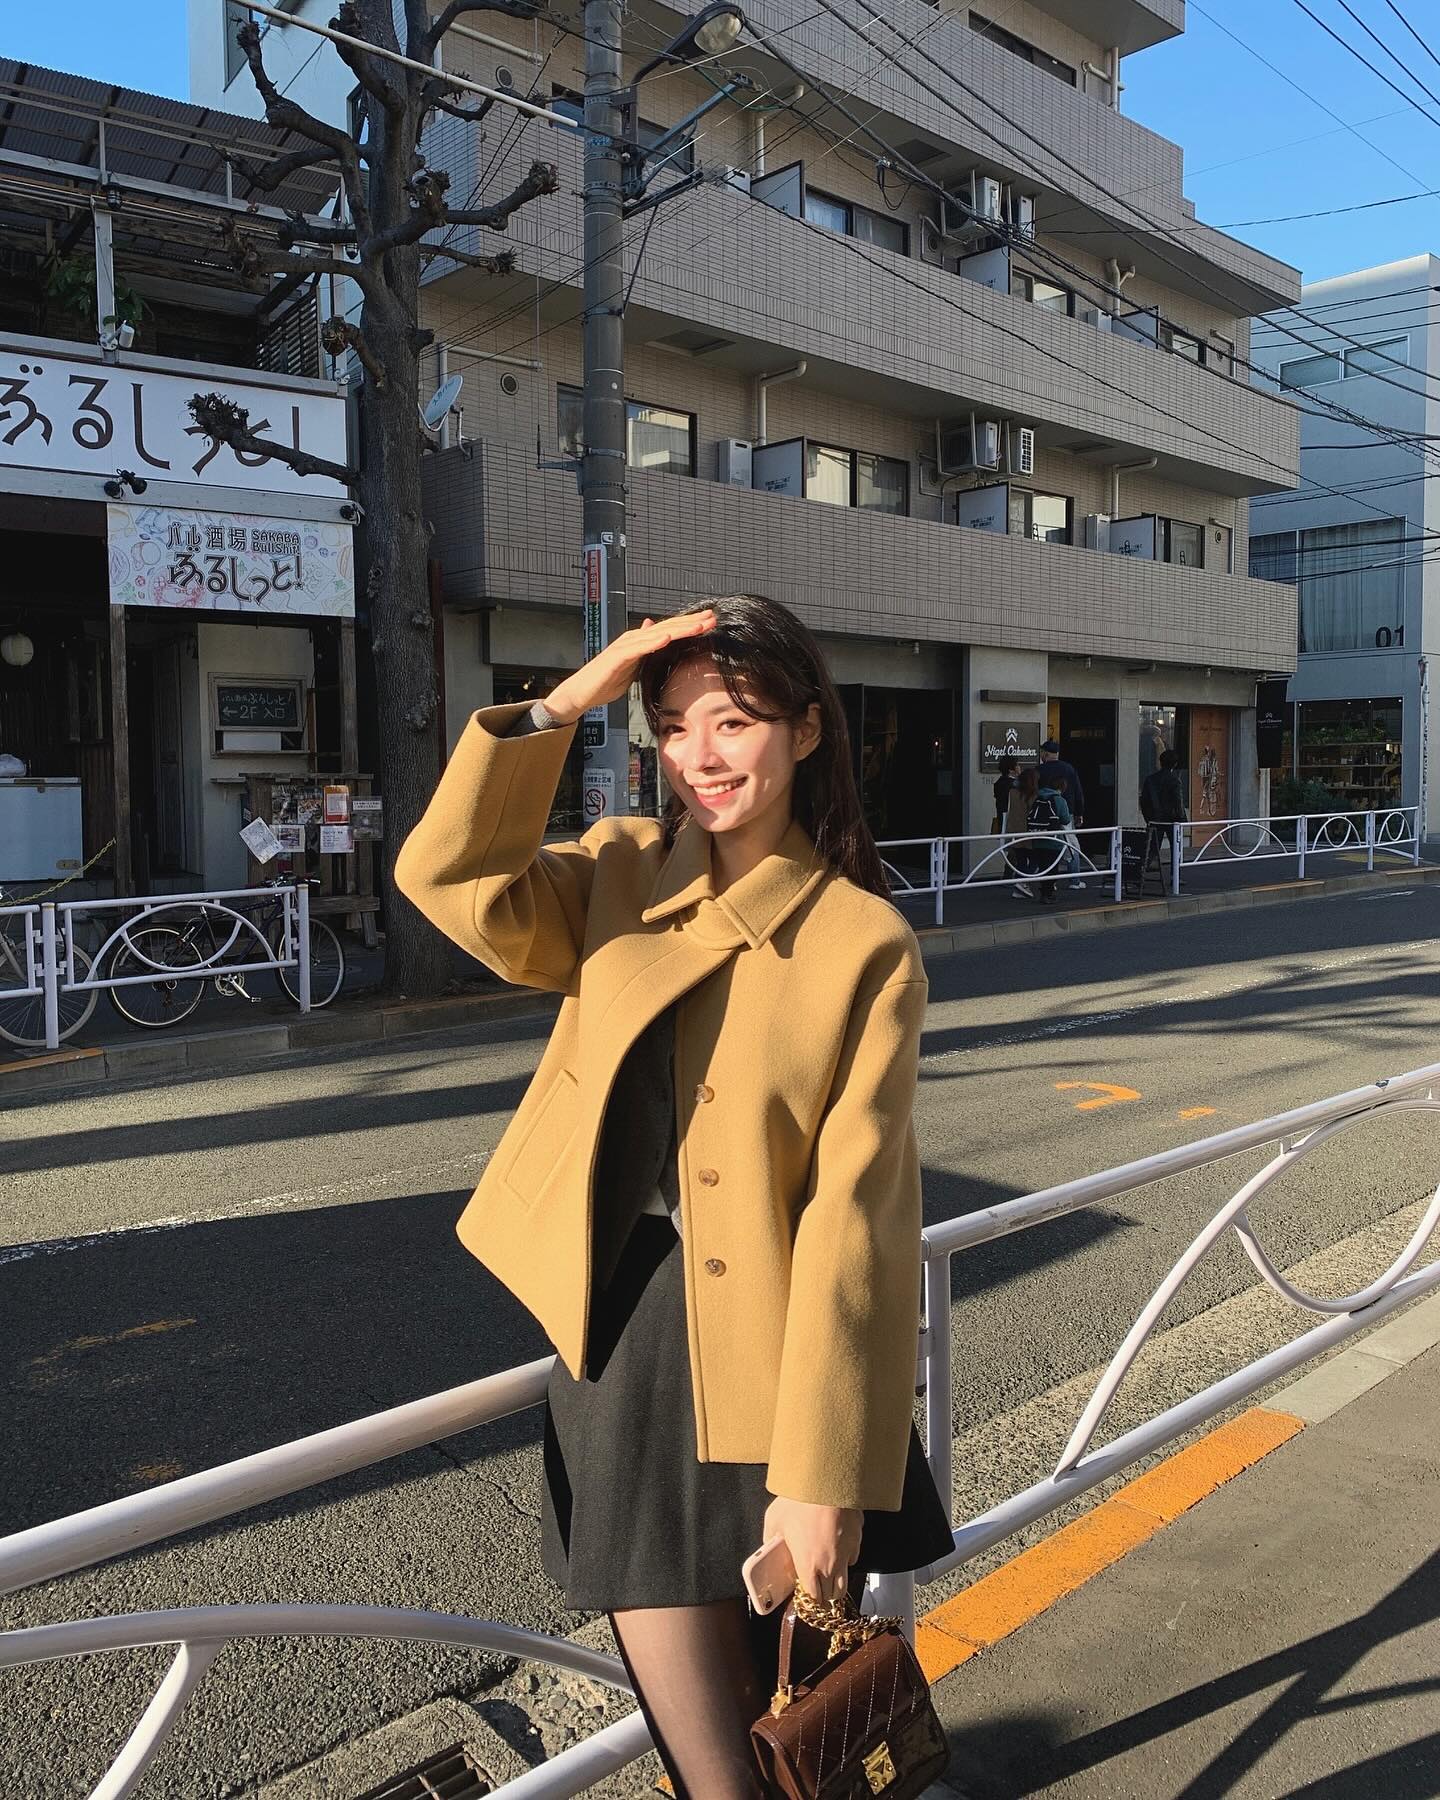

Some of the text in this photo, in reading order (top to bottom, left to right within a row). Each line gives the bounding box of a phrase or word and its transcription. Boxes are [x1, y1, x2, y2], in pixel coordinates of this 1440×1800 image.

[166, 522, 247, 551] バル酒場
[251, 529, 300, 543] SAKABA
[167, 545, 303, 605] ぶるしっと!
[1375, 625, 1405, 648] 01
[239, 704, 286, 720] 2F 入口
[984, 744, 1007, 760] Nigel
